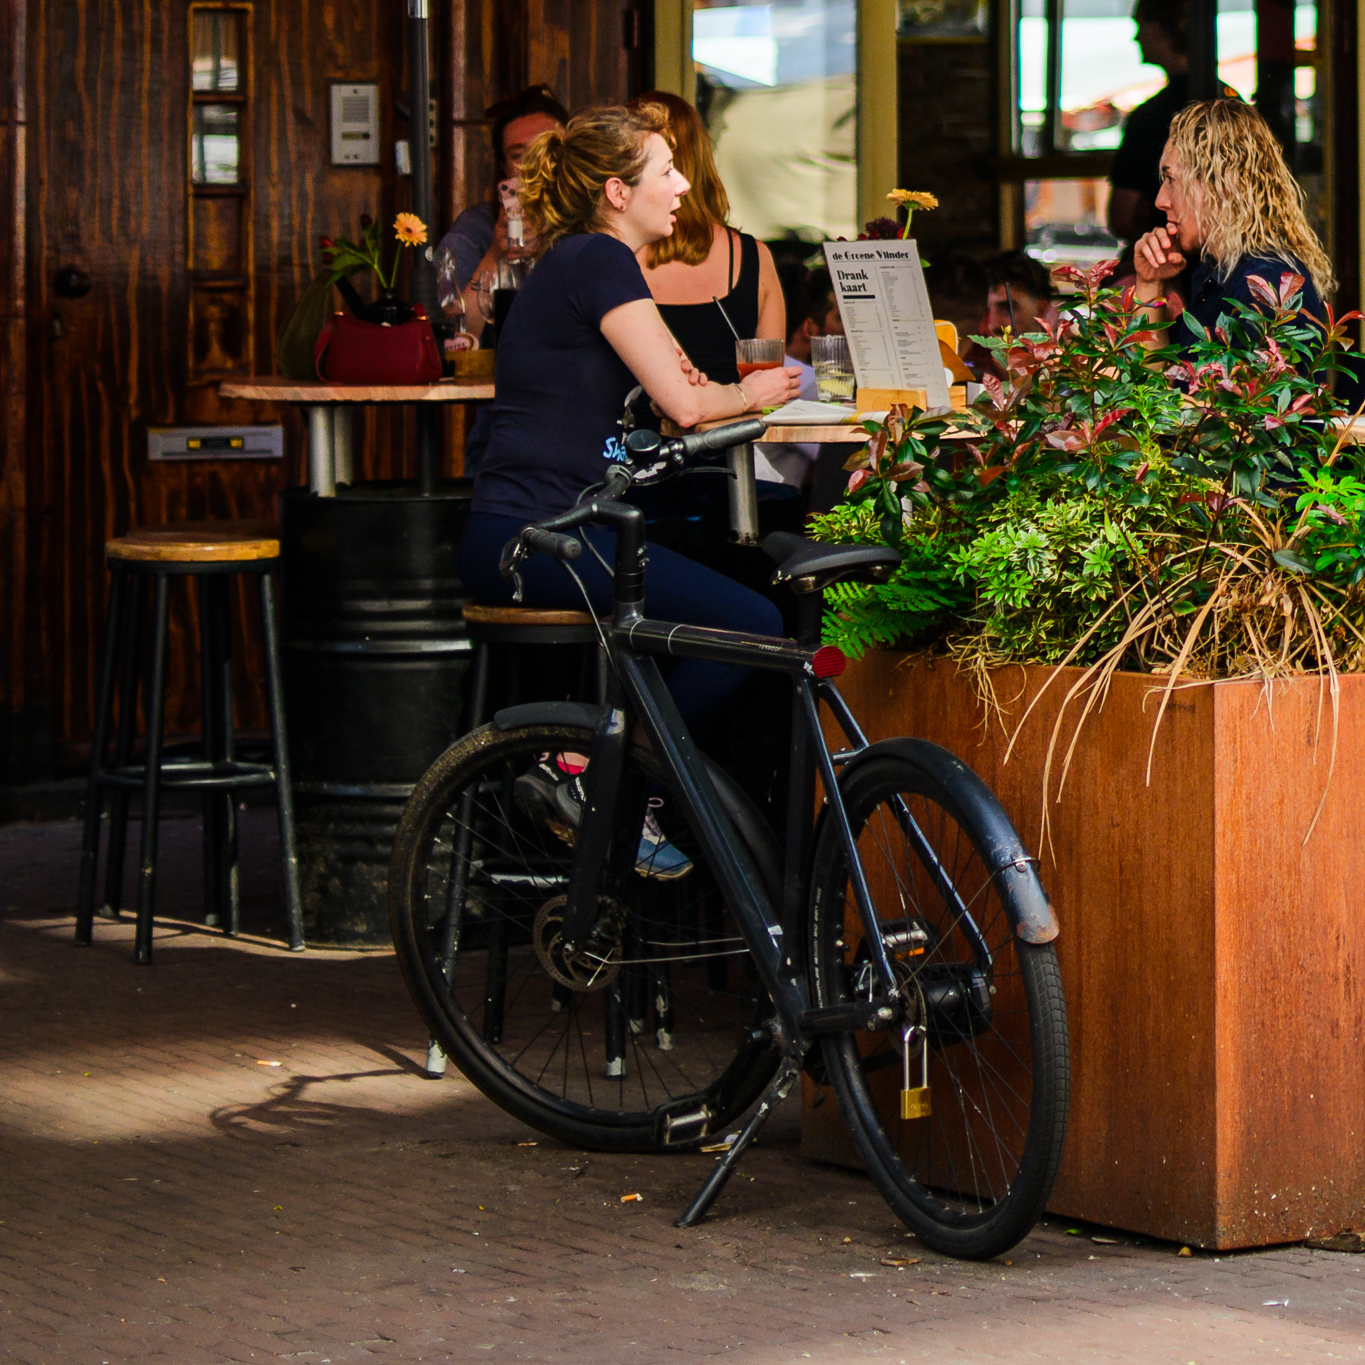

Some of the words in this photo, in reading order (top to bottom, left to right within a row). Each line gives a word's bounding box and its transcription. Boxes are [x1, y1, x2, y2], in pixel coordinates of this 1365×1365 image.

[832, 252, 843, 261] de
[844, 250, 875, 260] Groene
[876, 250, 909, 260] Vlinder
[836, 268, 869, 281] Drank
[839, 281, 867, 293] kaart
